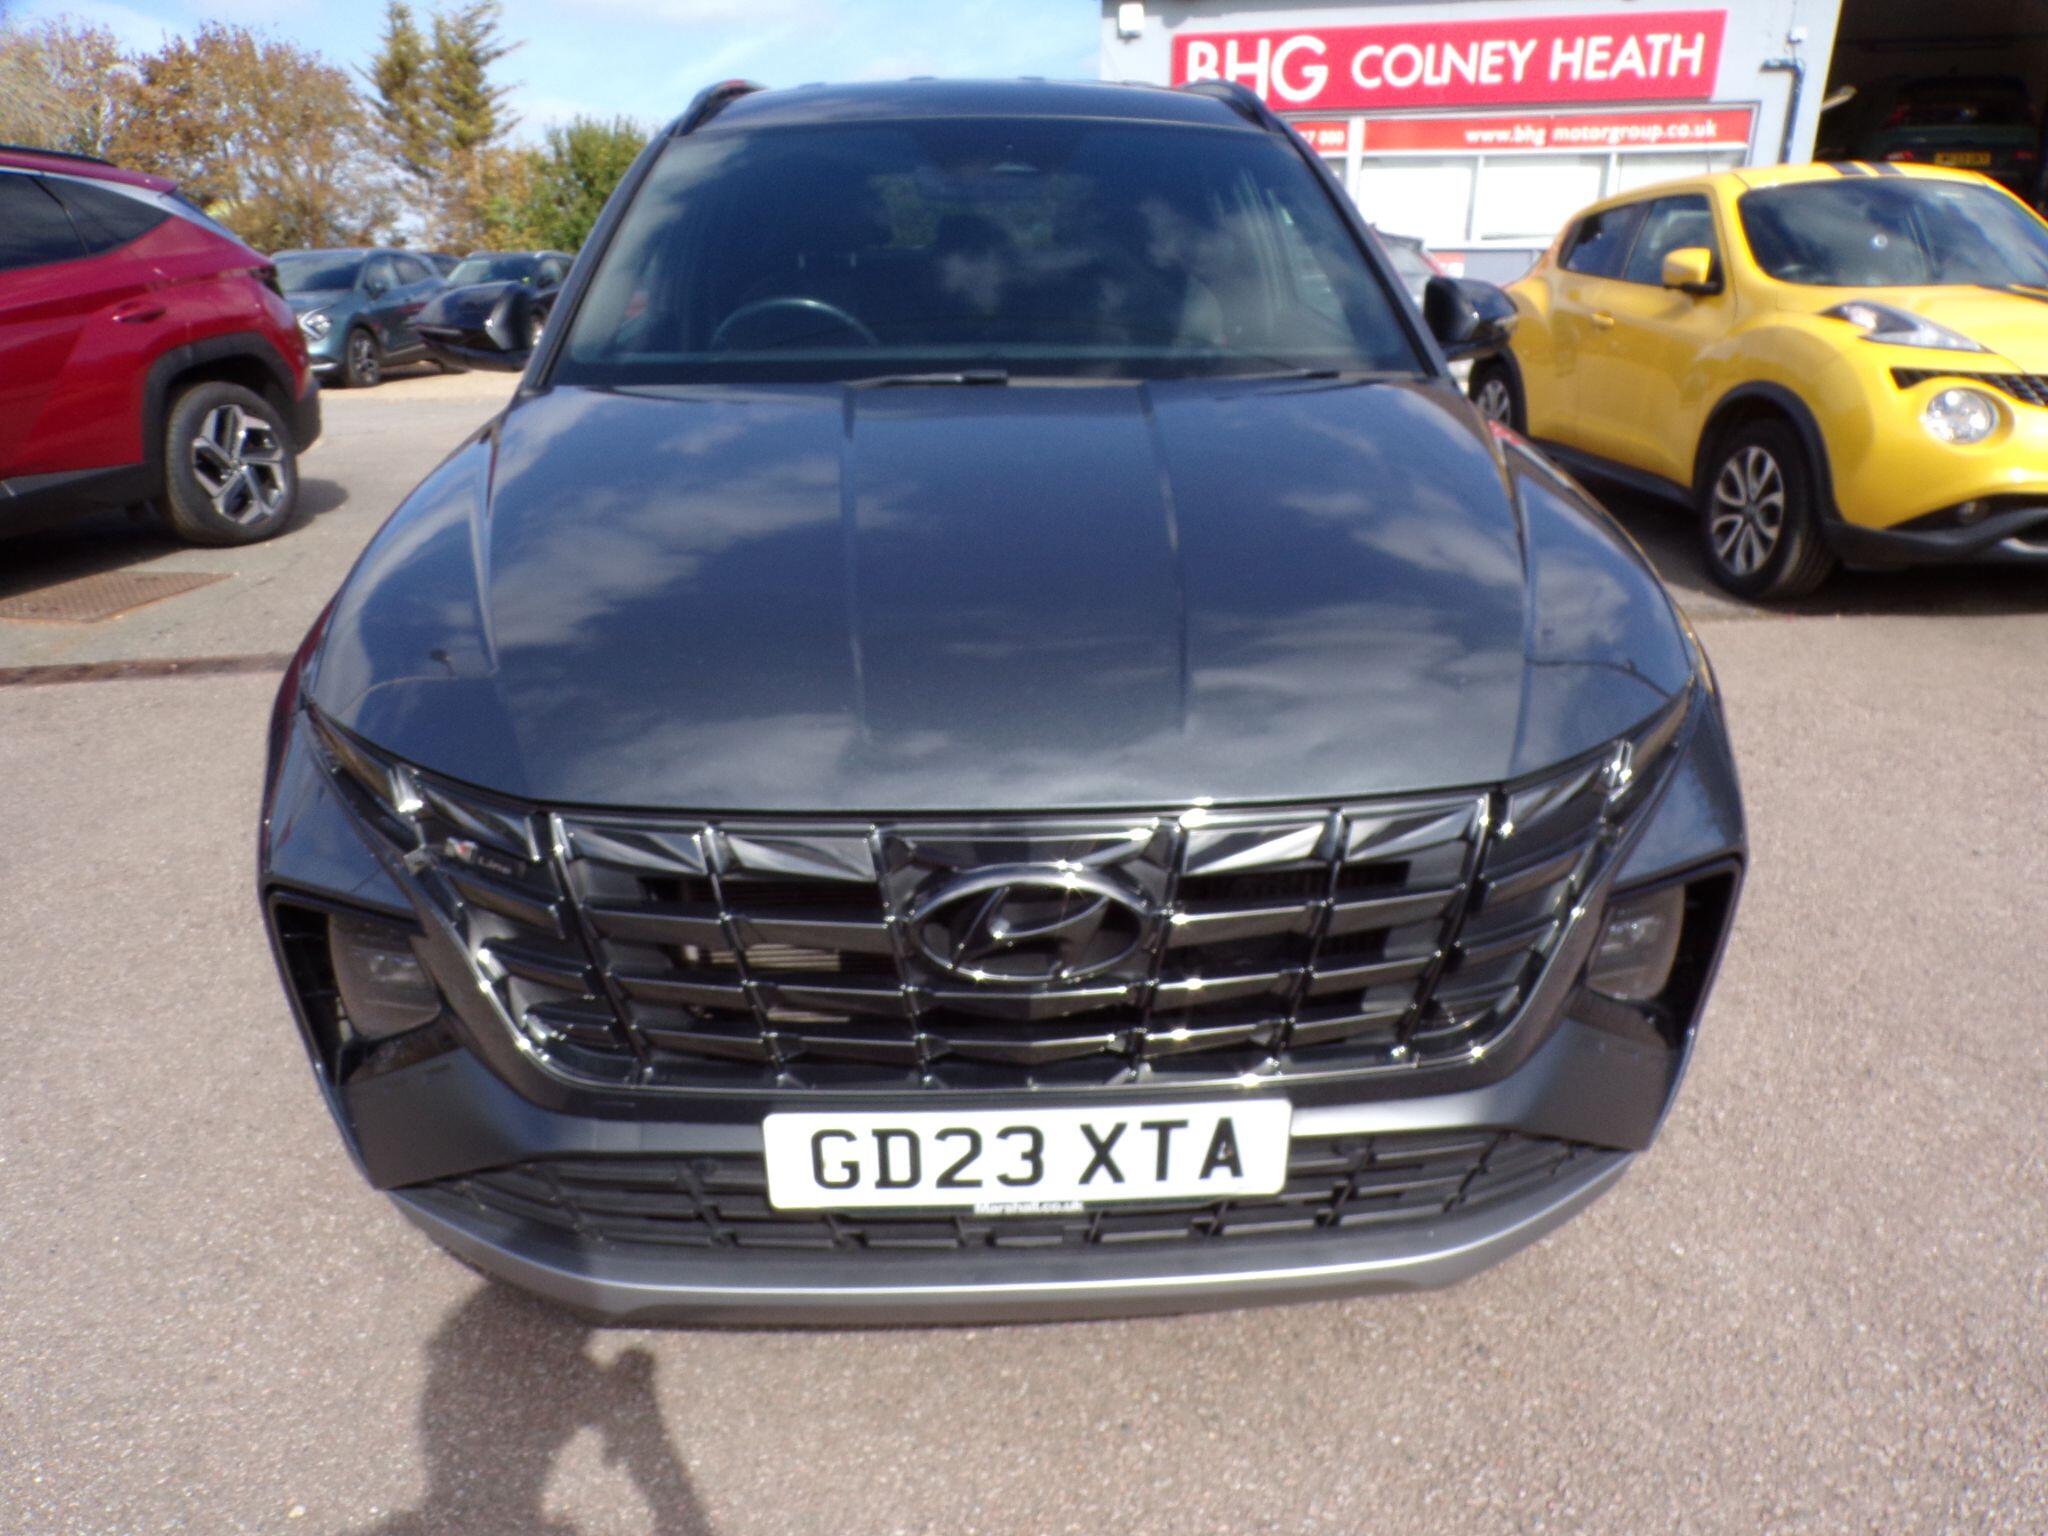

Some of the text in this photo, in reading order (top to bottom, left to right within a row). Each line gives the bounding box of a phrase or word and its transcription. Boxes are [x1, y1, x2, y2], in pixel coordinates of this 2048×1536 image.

[1187, 32, 1705, 102] BHG COLNEY HEATH
[811, 1119, 1241, 1189] GD23 XTA
